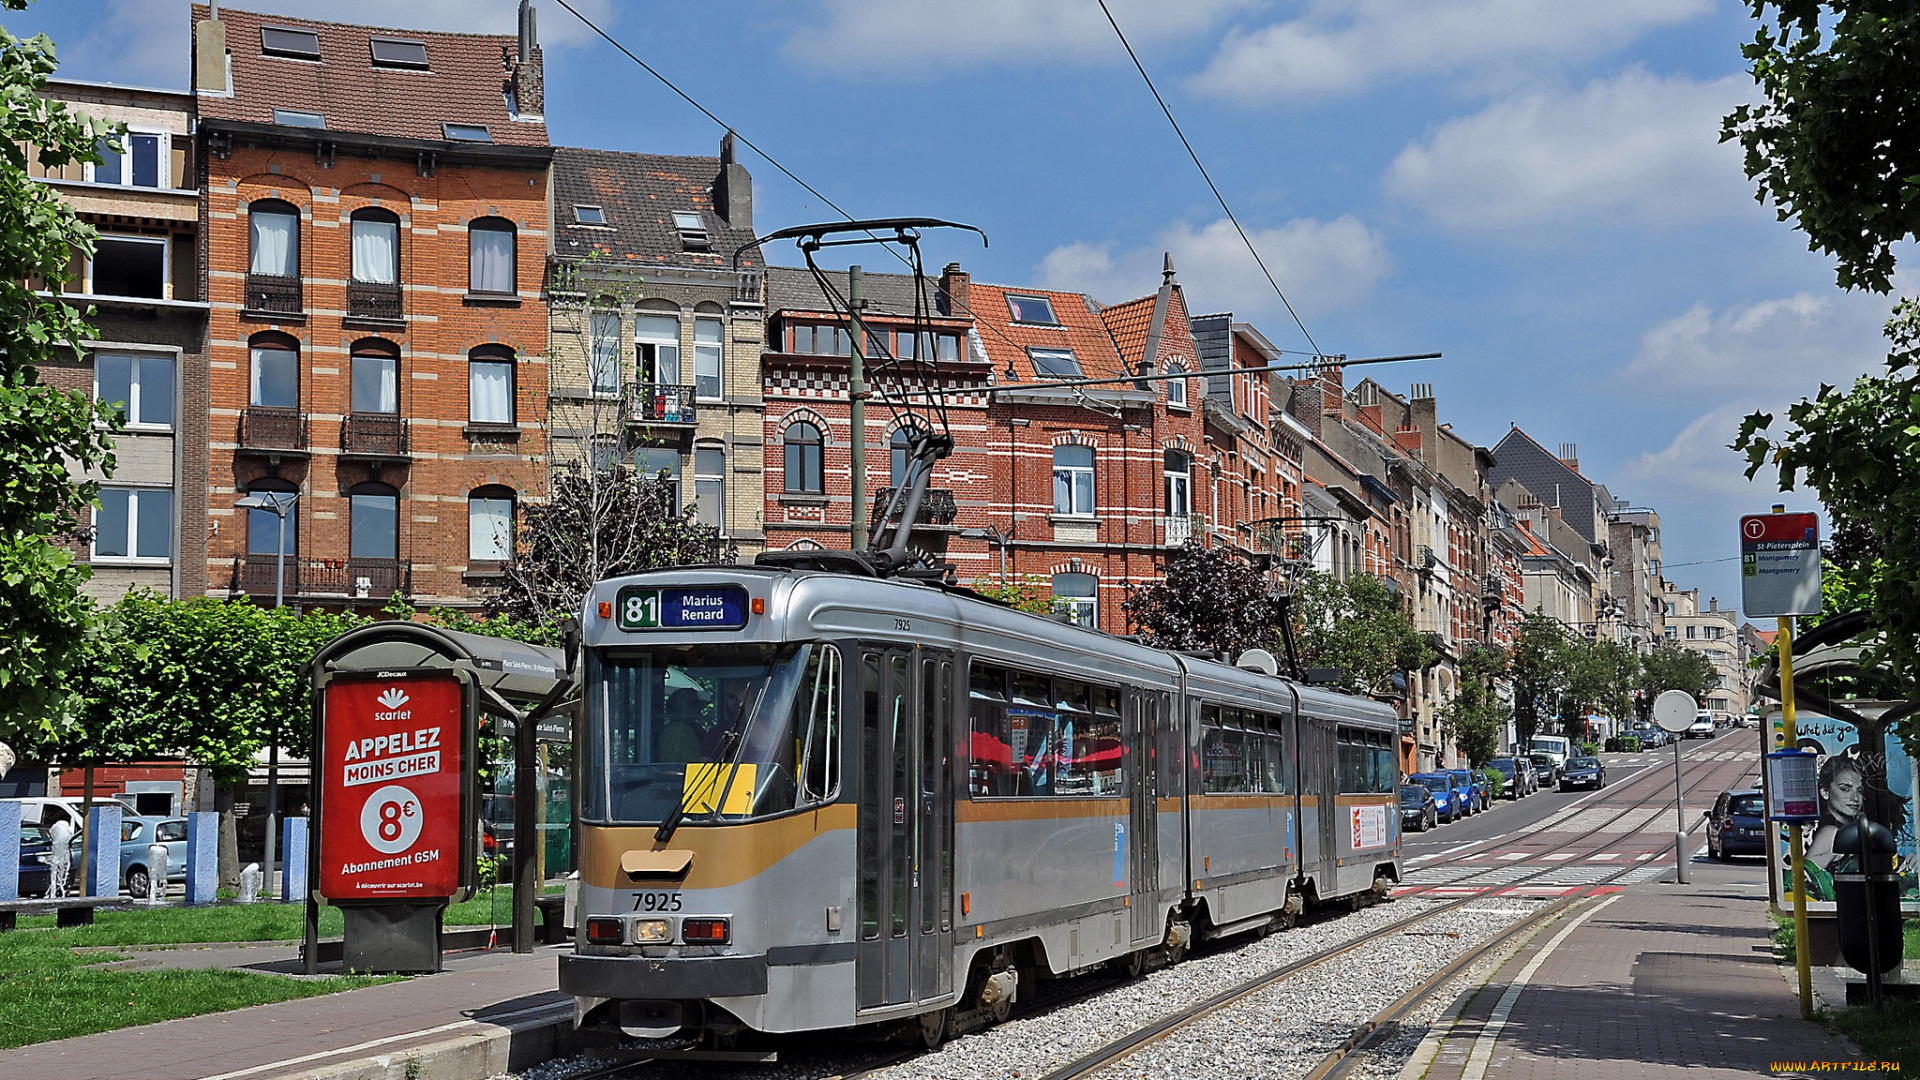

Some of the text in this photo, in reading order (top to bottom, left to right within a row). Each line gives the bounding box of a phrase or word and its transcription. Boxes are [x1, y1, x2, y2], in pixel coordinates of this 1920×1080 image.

[1757, 541, 1810, 551] St-Pietersplein
[1744, 554, 1755, 563] 81
[1758, 554, 1800, 563] Montgomery
[1744, 566, 1756, 575] 83
[1758, 567, 1801, 576] Montgomery
[682, 595, 724, 607] Marius
[626, 596, 657, 623] 81
[681, 608, 725, 621] Renard
[894, 618, 911, 632] 7925
[374, 710, 412, 721] scarlet
[1795, 724, 1820, 737] What
[1822, 724, 1835, 736] did
[344, 726, 441, 762] APPELEZ
[347, 755, 436, 782] MOINS CHER
[341, 849, 440, 875] Abonnement GSM
[631, 892, 682, 912] 7925
